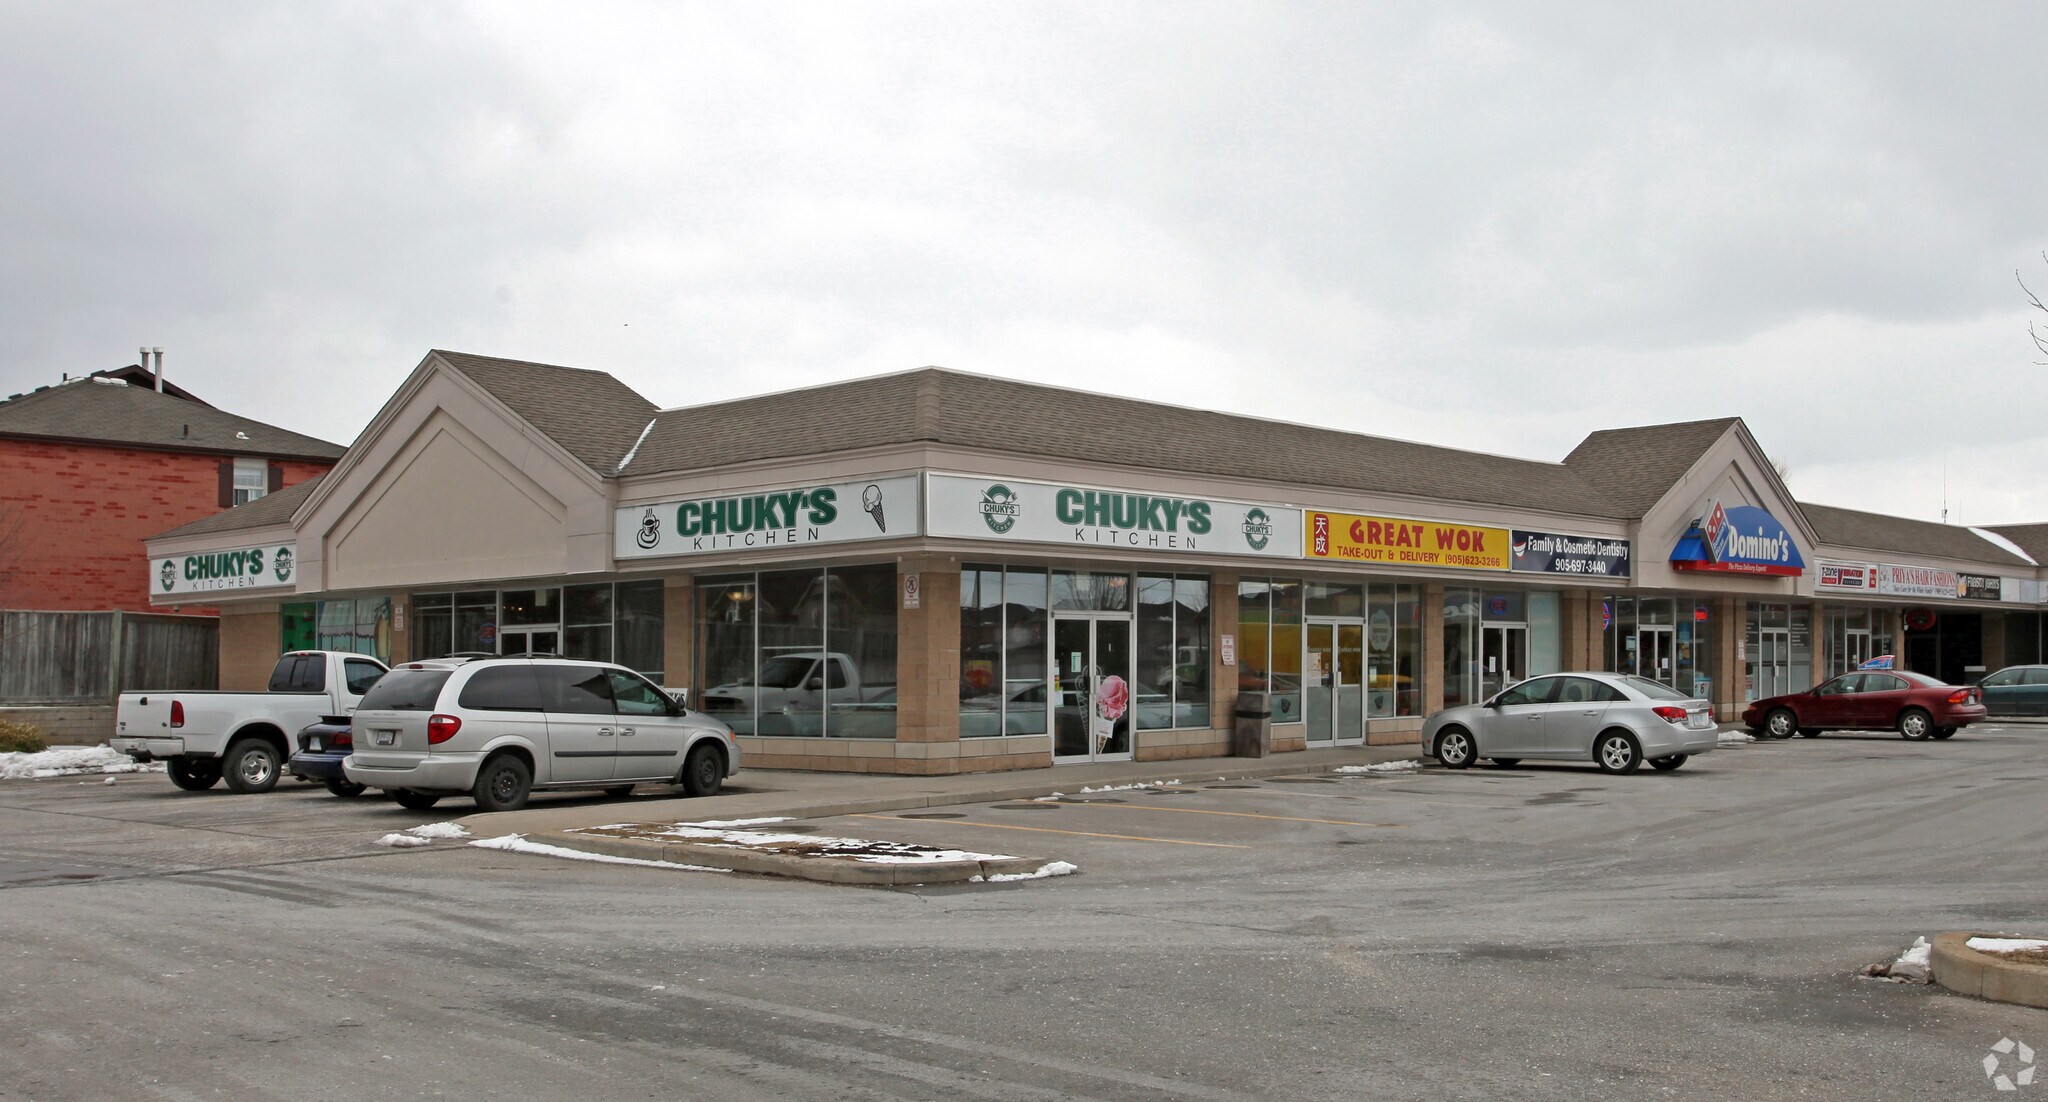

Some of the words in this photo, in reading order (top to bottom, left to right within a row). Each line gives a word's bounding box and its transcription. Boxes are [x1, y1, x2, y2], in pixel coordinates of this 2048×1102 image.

[676, 487, 838, 538] CHUKY'S
[984, 503, 1015, 514] CHUKY'S
[1055, 487, 1213, 536] CHUKY'S
[693, 526, 819, 550] KITCHEN
[1075, 528, 1197, 549] KITCHEN
[1315, 517, 1327, 554] 天成
[1349, 519, 1424, 548] GREAT
[1435, 527, 1485, 552] WOK
[1728, 525, 1789, 562] Domino's
[1337, 545, 1383, 559] TAKE-OUT
[1388, 550, 1395, 560] &
[1400, 551, 1439, 562] DELIVERY
[1527, 536, 1554, 555] Family
[1555, 538, 1562, 553] &
[1563, 538, 1596, 555] Cosmetic
[1597, 541, 1629, 560] Dentistry
[184, 549, 264, 581] CHUKY'S
[1555, 558, 1606, 573] 905-697-3440
[192, 577, 255, 590] KITCHEN
